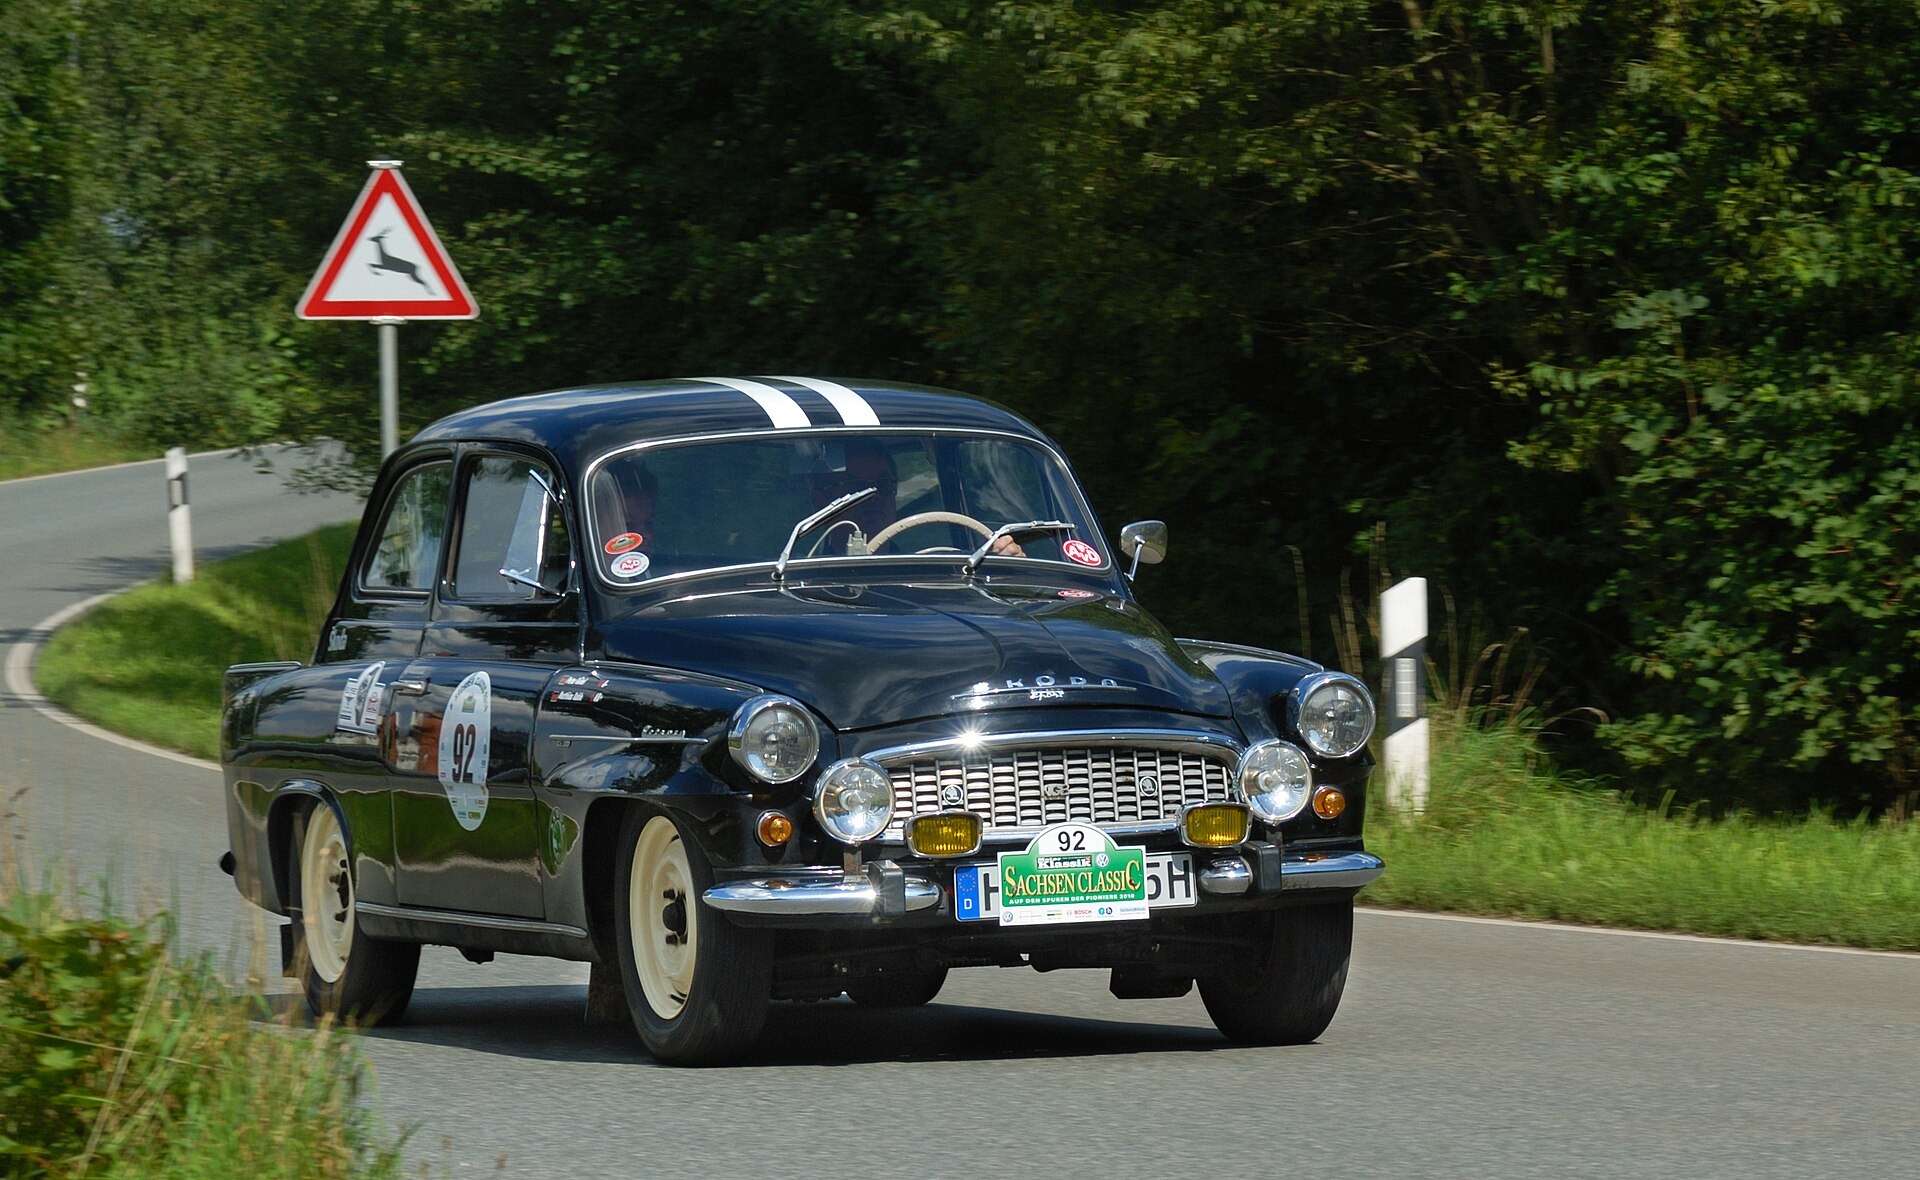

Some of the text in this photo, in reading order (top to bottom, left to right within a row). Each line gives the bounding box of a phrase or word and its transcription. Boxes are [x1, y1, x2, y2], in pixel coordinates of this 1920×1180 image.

[973, 675, 1118, 694] KODA
[452, 723, 476, 784] 92
[1057, 830, 1086, 851] 92
[1005, 859, 1141, 897] SACHSEN CLASSIC
[963, 898, 973, 910] D
